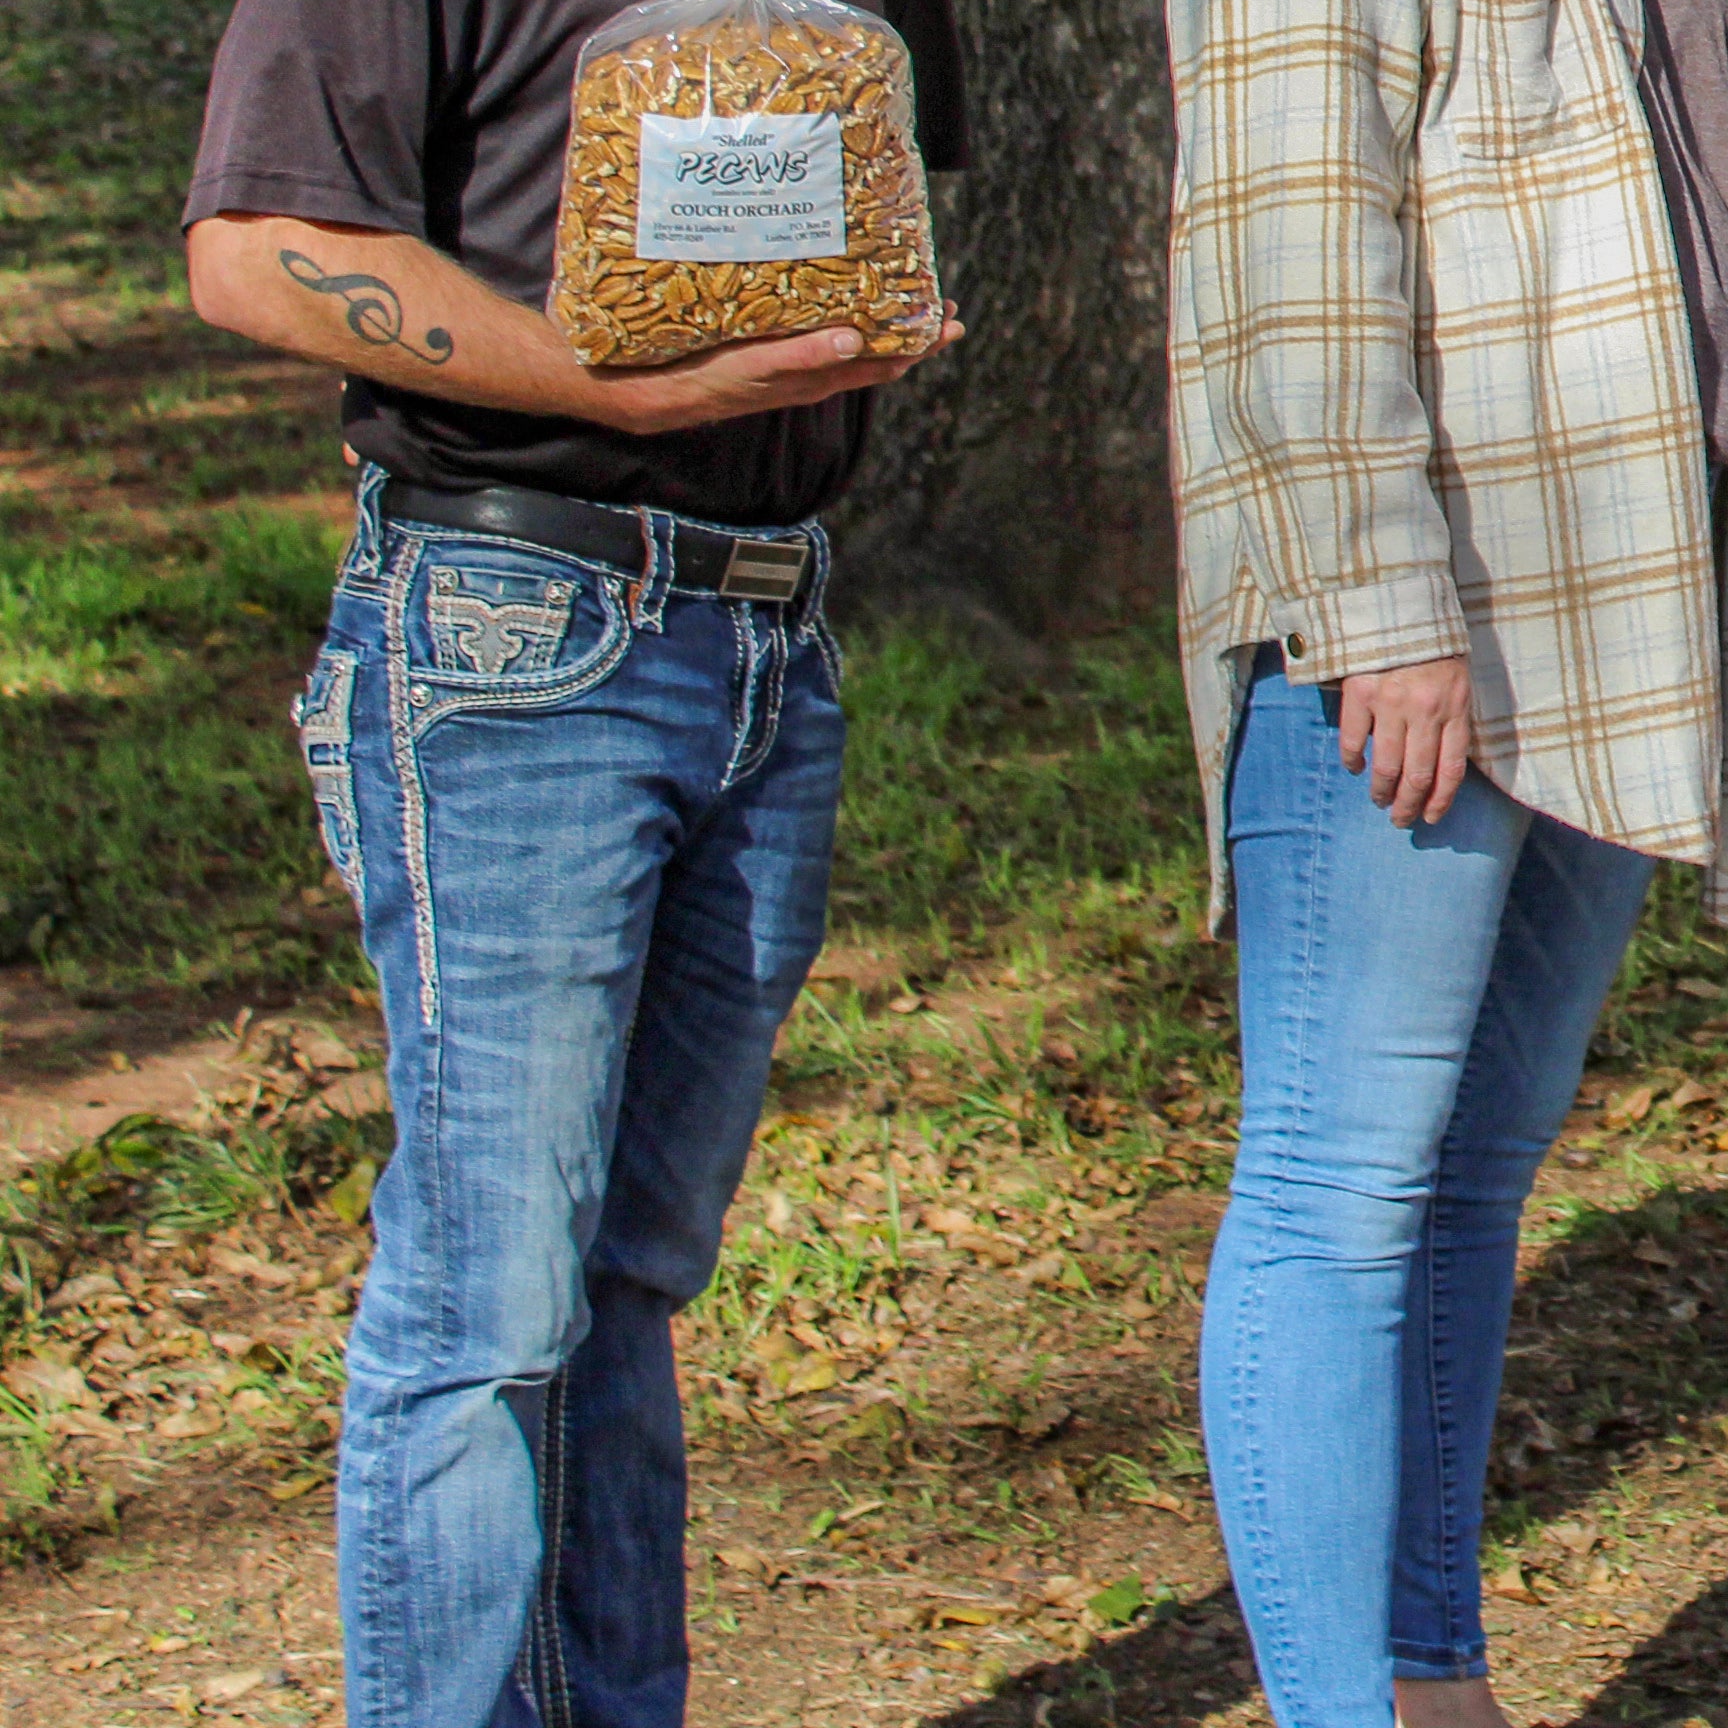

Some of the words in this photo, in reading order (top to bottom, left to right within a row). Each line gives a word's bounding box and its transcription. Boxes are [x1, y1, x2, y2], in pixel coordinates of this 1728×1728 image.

[674, 150, 809, 185] PECANS
[671, 203, 730, 217] COUCH
[733, 201, 814, 218] ORCHARD
